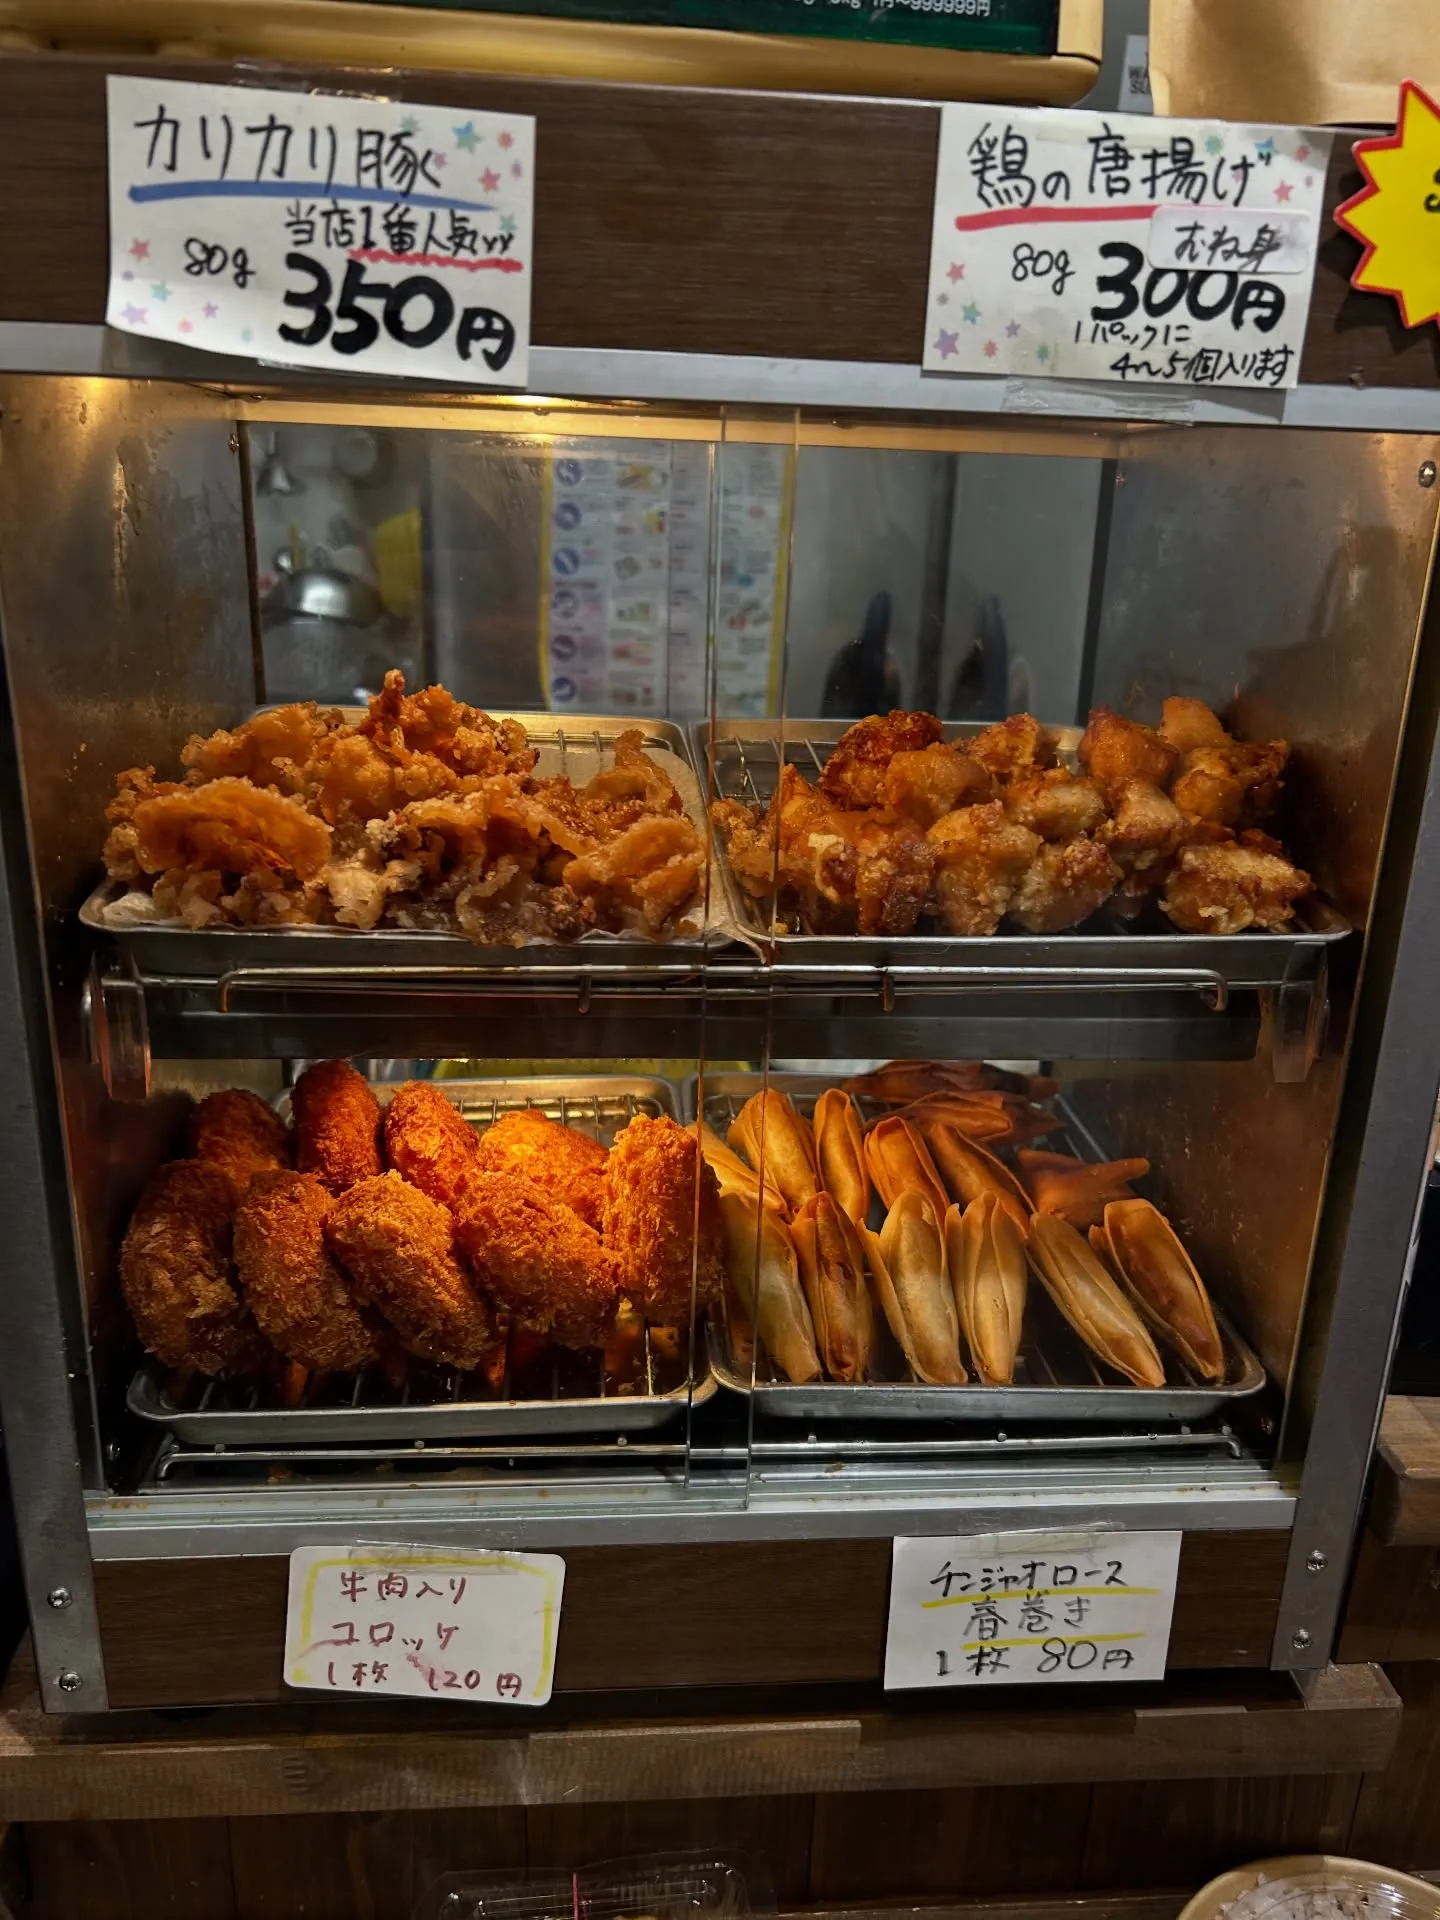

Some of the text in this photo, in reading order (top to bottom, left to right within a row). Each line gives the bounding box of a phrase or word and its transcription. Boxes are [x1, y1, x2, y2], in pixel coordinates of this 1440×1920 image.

[134, 104, 442, 197] カリカリ豚
[967, 121, 1272, 207] 鶏の唐揚げ
[183, 237, 516, 371] 80g 350円
[1011, 241, 1286, 332] 80g 300円
[340, 1571, 467, 1605] 牛肉入り
[930, 1559, 1129, 1597] チンジャオロース
[332, 1621, 460, 1651] コロッケ
[962, 1590, 1093, 1640] 春巻き
[327, 1660, 523, 1698] 1枚 120円
[936, 1636, 1135, 1677] 1枚 80円
